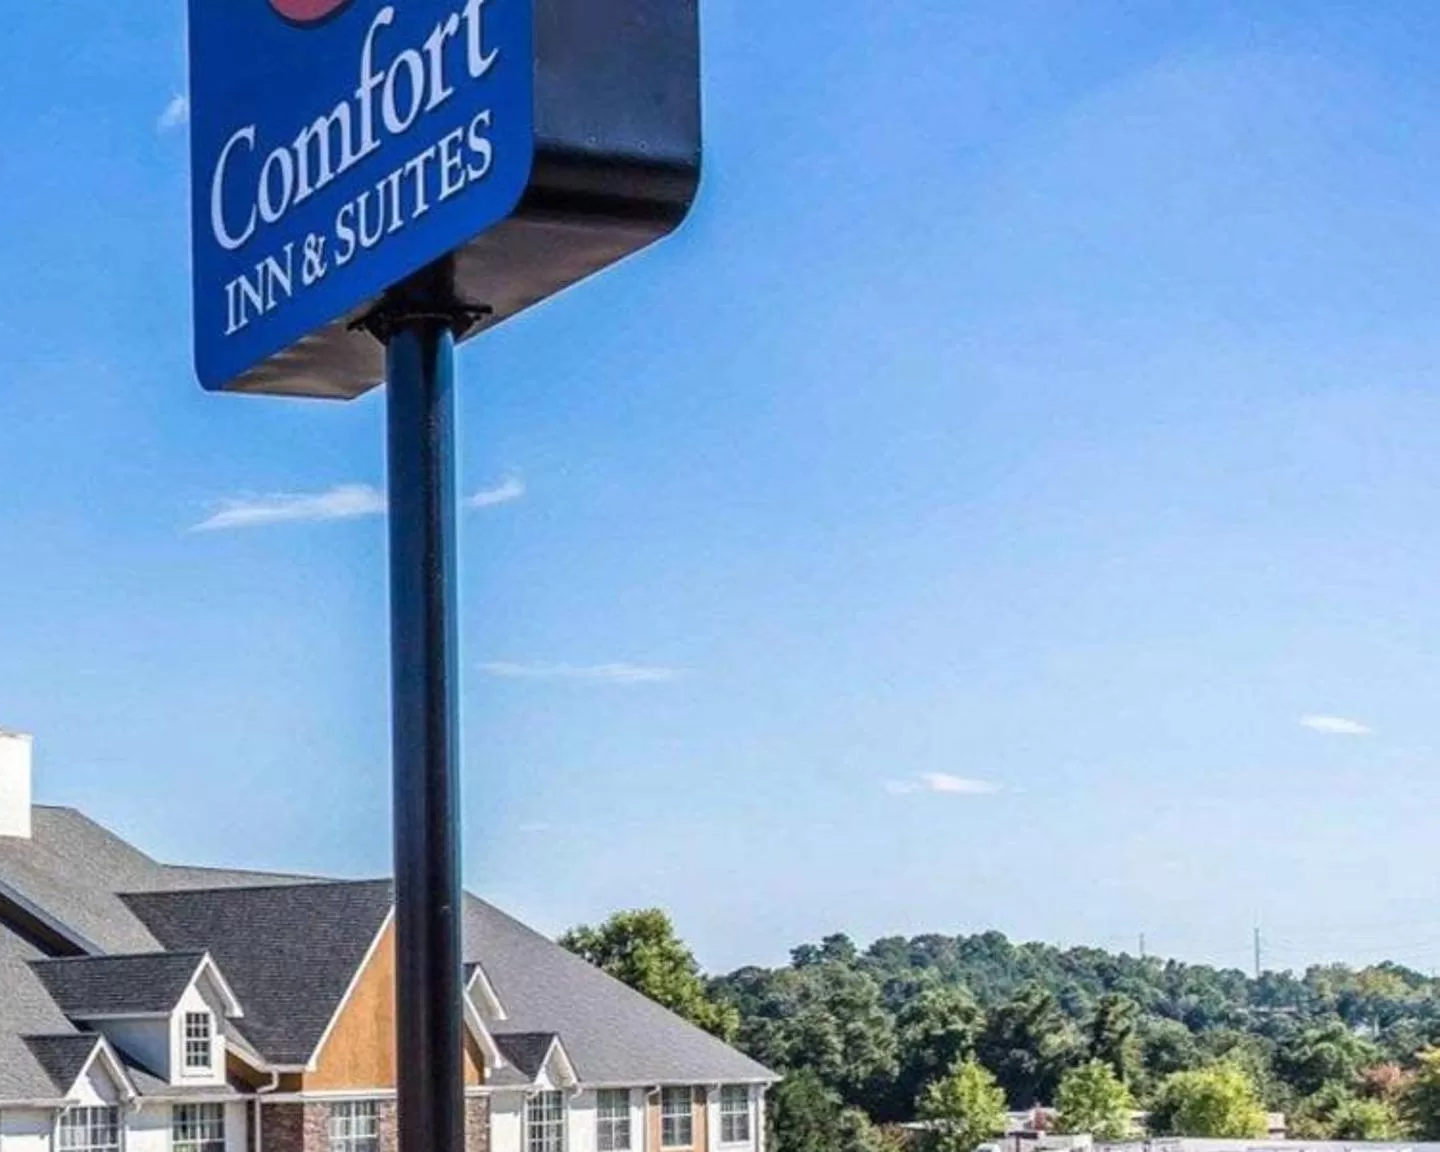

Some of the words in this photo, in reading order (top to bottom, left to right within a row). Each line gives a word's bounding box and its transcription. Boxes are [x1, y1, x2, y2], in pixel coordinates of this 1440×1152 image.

[211, 0, 499, 250] Comfort
[224, 242, 295, 337] INN
[301, 232, 328, 286] &
[334, 109, 493, 267] SUITES
